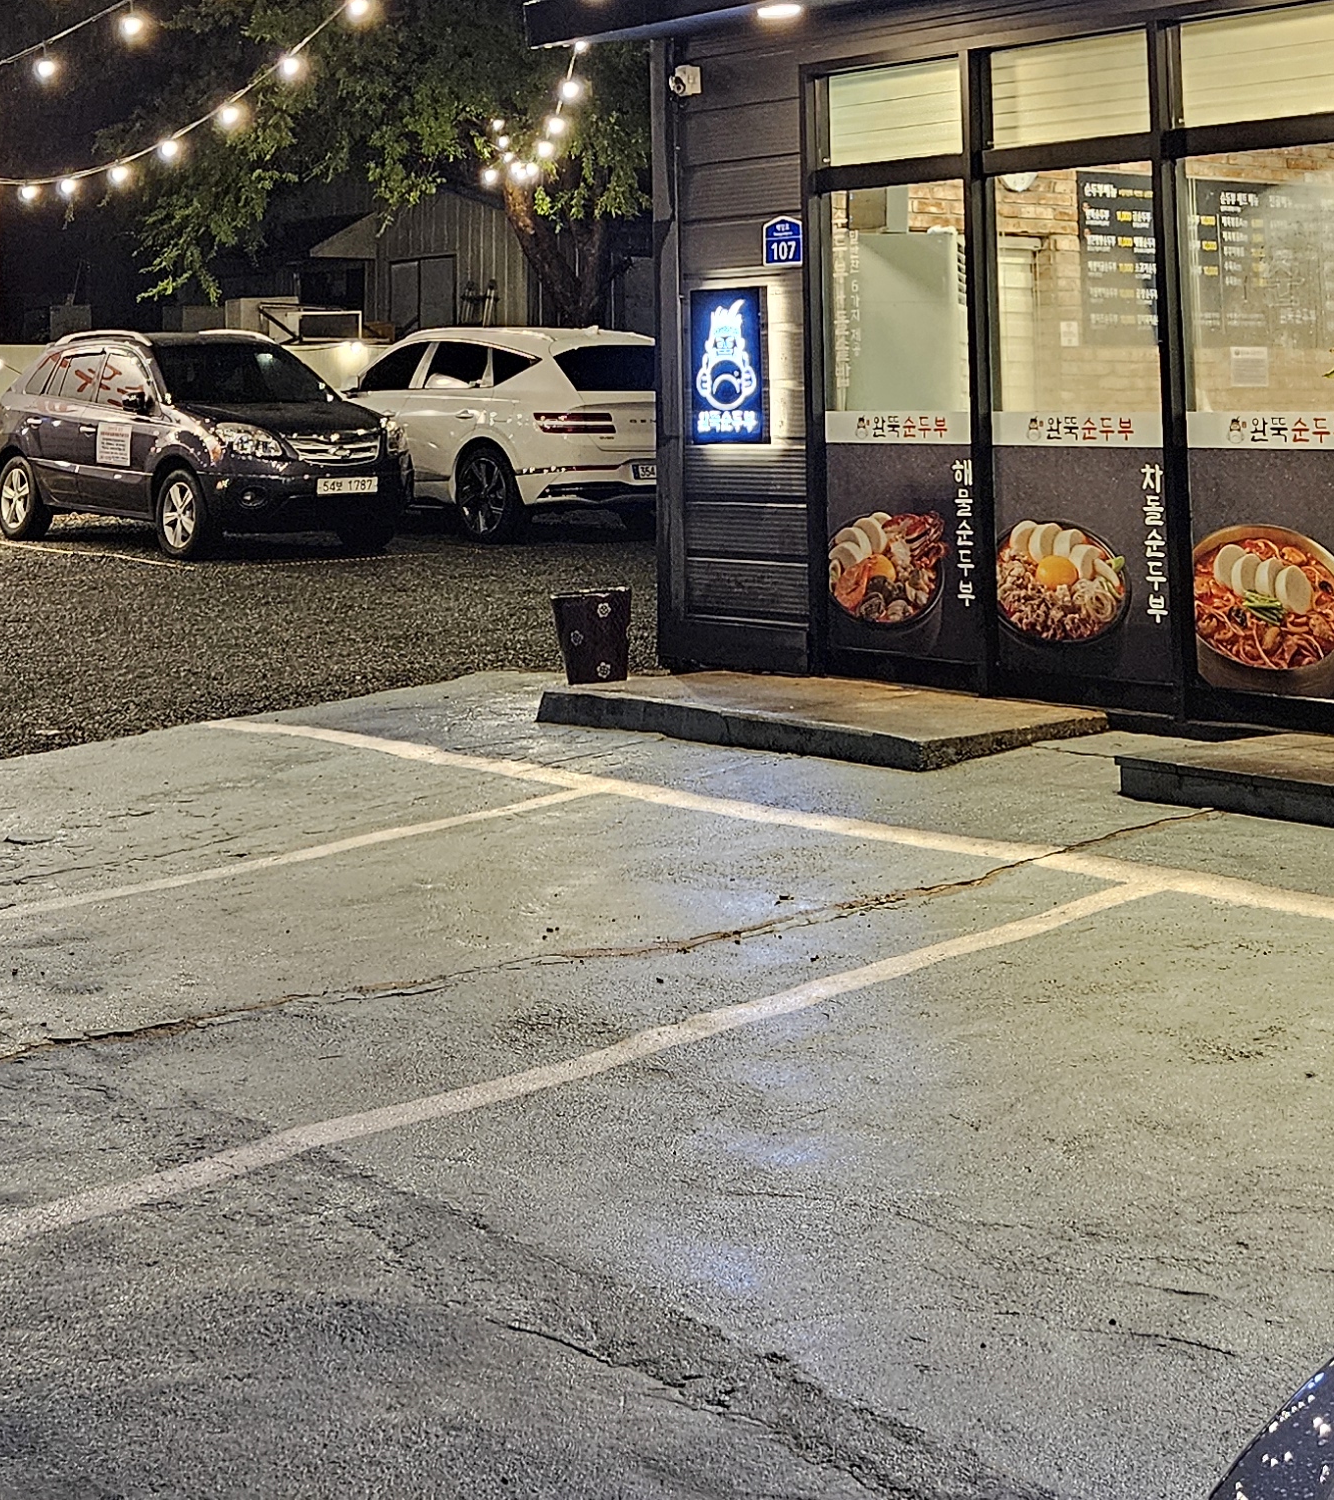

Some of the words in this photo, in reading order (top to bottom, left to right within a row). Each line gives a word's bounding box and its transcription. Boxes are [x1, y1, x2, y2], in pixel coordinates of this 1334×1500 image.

[770, 240, 797, 260] 107
[871, 415, 948, 438] 완뚝순두부
[1046, 416, 1134, 441] 완뚝순두부
[950, 458, 976, 608] 해물순두부
[1139, 462, 1169, 624] 차돌순두부
